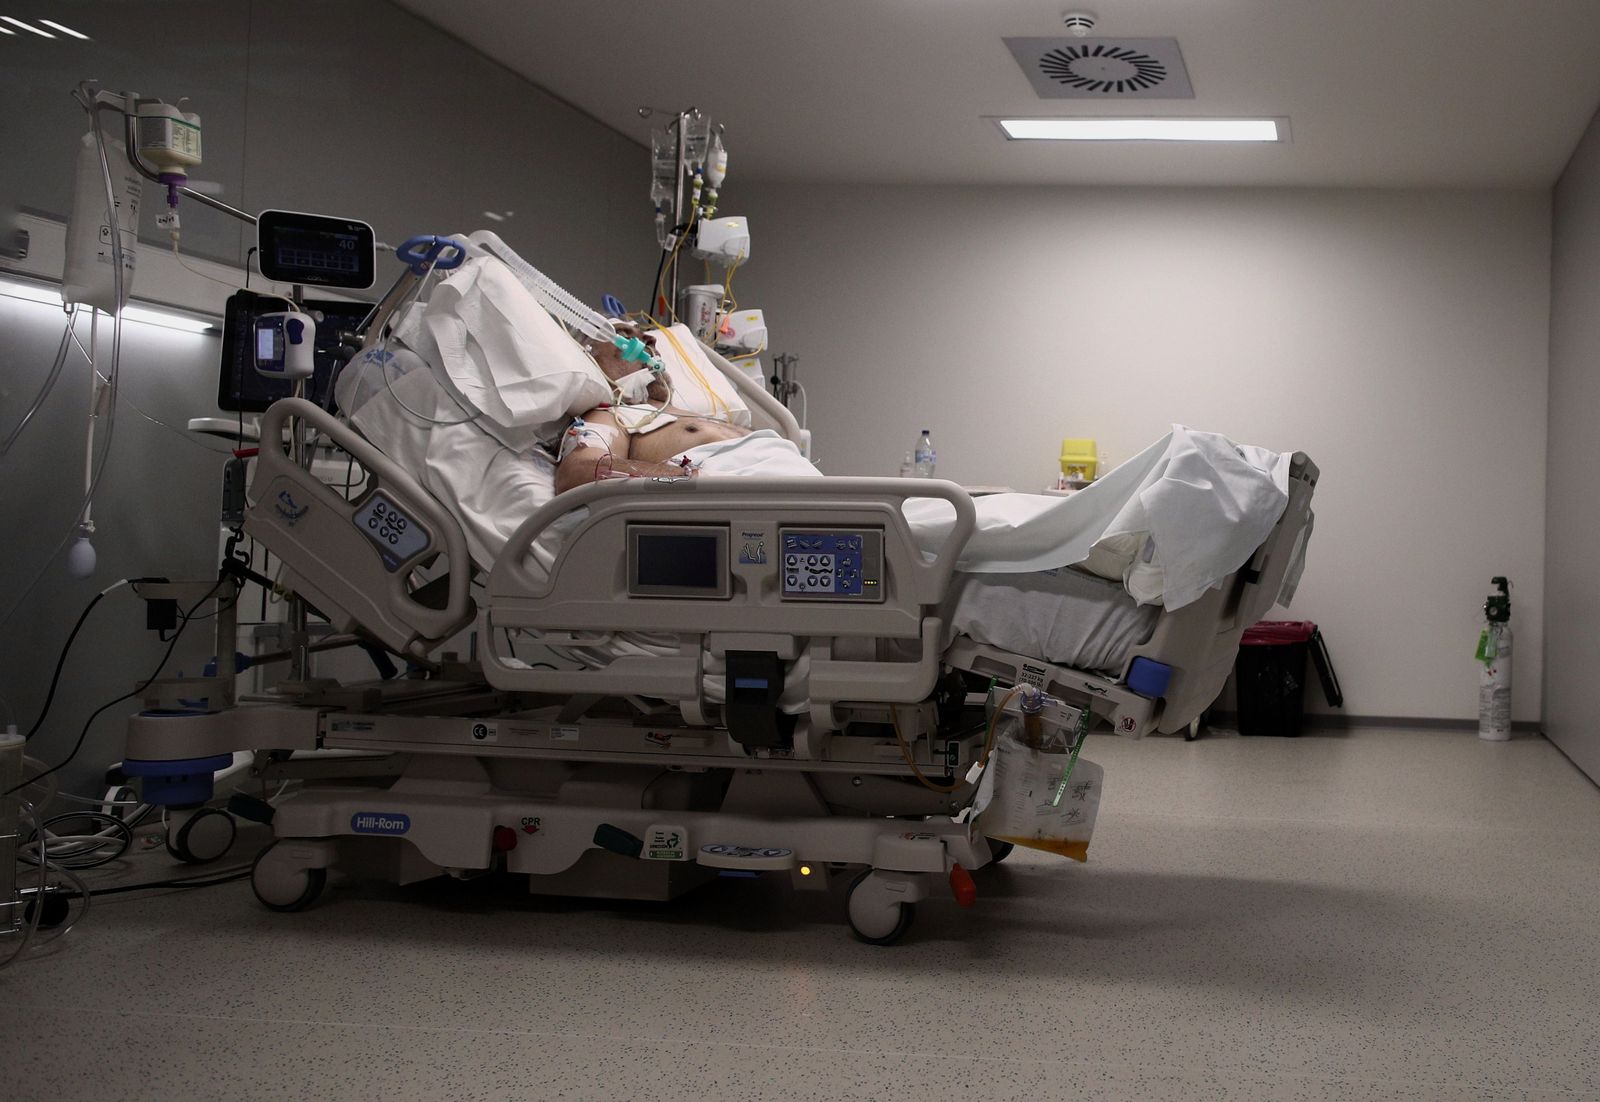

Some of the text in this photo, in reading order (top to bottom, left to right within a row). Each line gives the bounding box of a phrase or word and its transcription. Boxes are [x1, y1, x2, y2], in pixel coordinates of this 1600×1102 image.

[338, 240, 355, 250] 40
[356, 816, 405, 830] Hill-Rom
[521, 817, 541, 826] CPR
